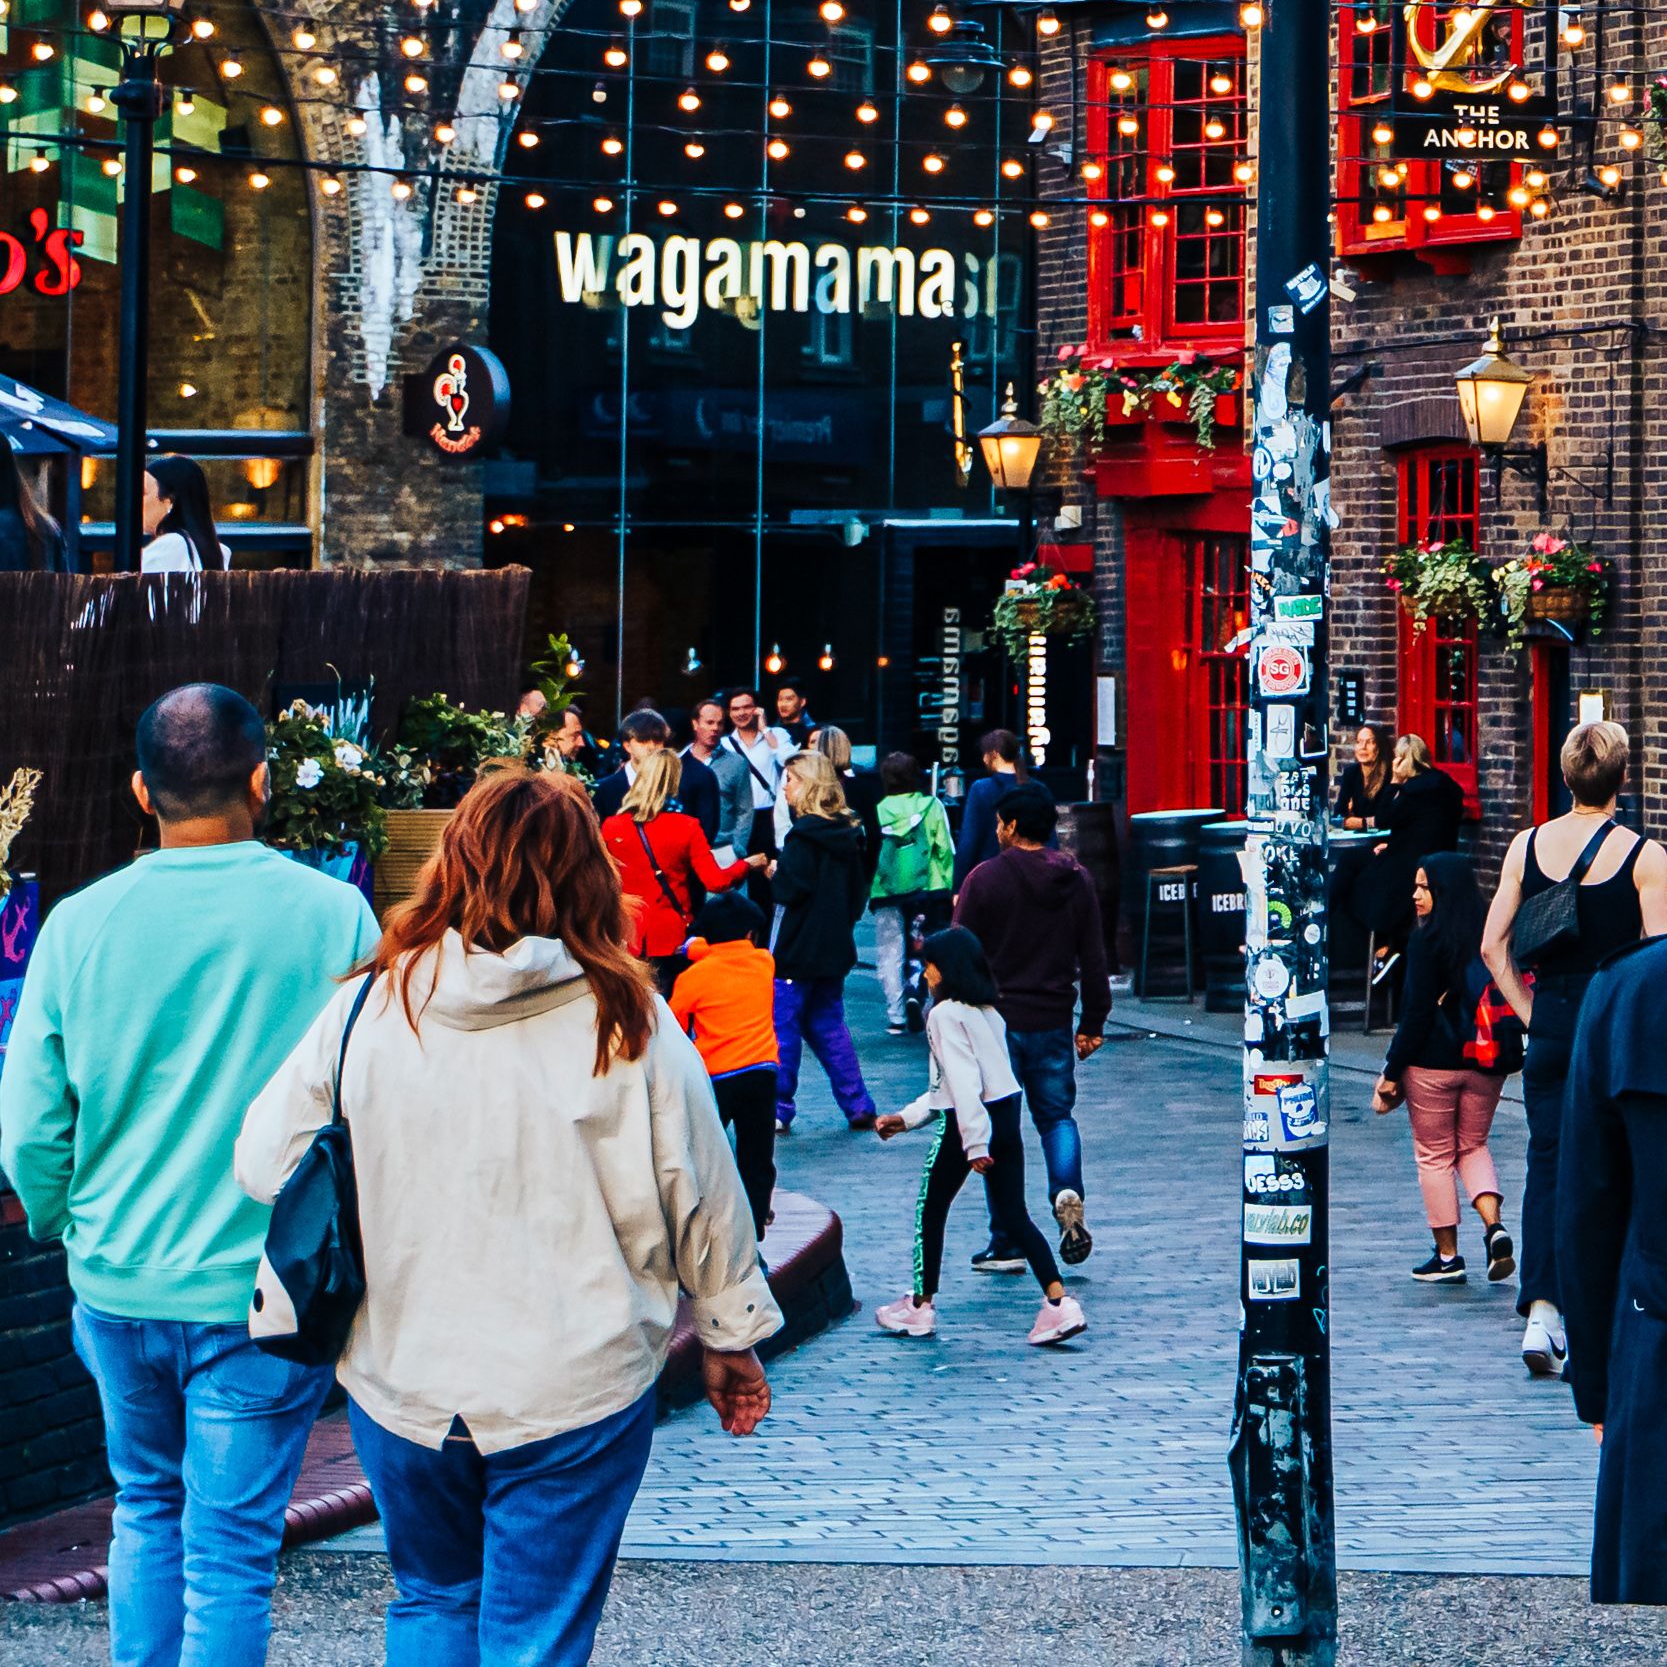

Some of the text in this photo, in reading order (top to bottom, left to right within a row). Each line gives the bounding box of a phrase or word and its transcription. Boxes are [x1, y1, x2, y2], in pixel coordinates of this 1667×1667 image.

[1453, 104, 1500, 125] THE
[1423, 128, 1530, 150] ANCHOR
[554, 230, 955, 330] wagamama
[1270, 663, 1290, 675] SG
[1159, 882, 1198, 902] ICEB
[1211, 892, 1247, 913] ICEBR
